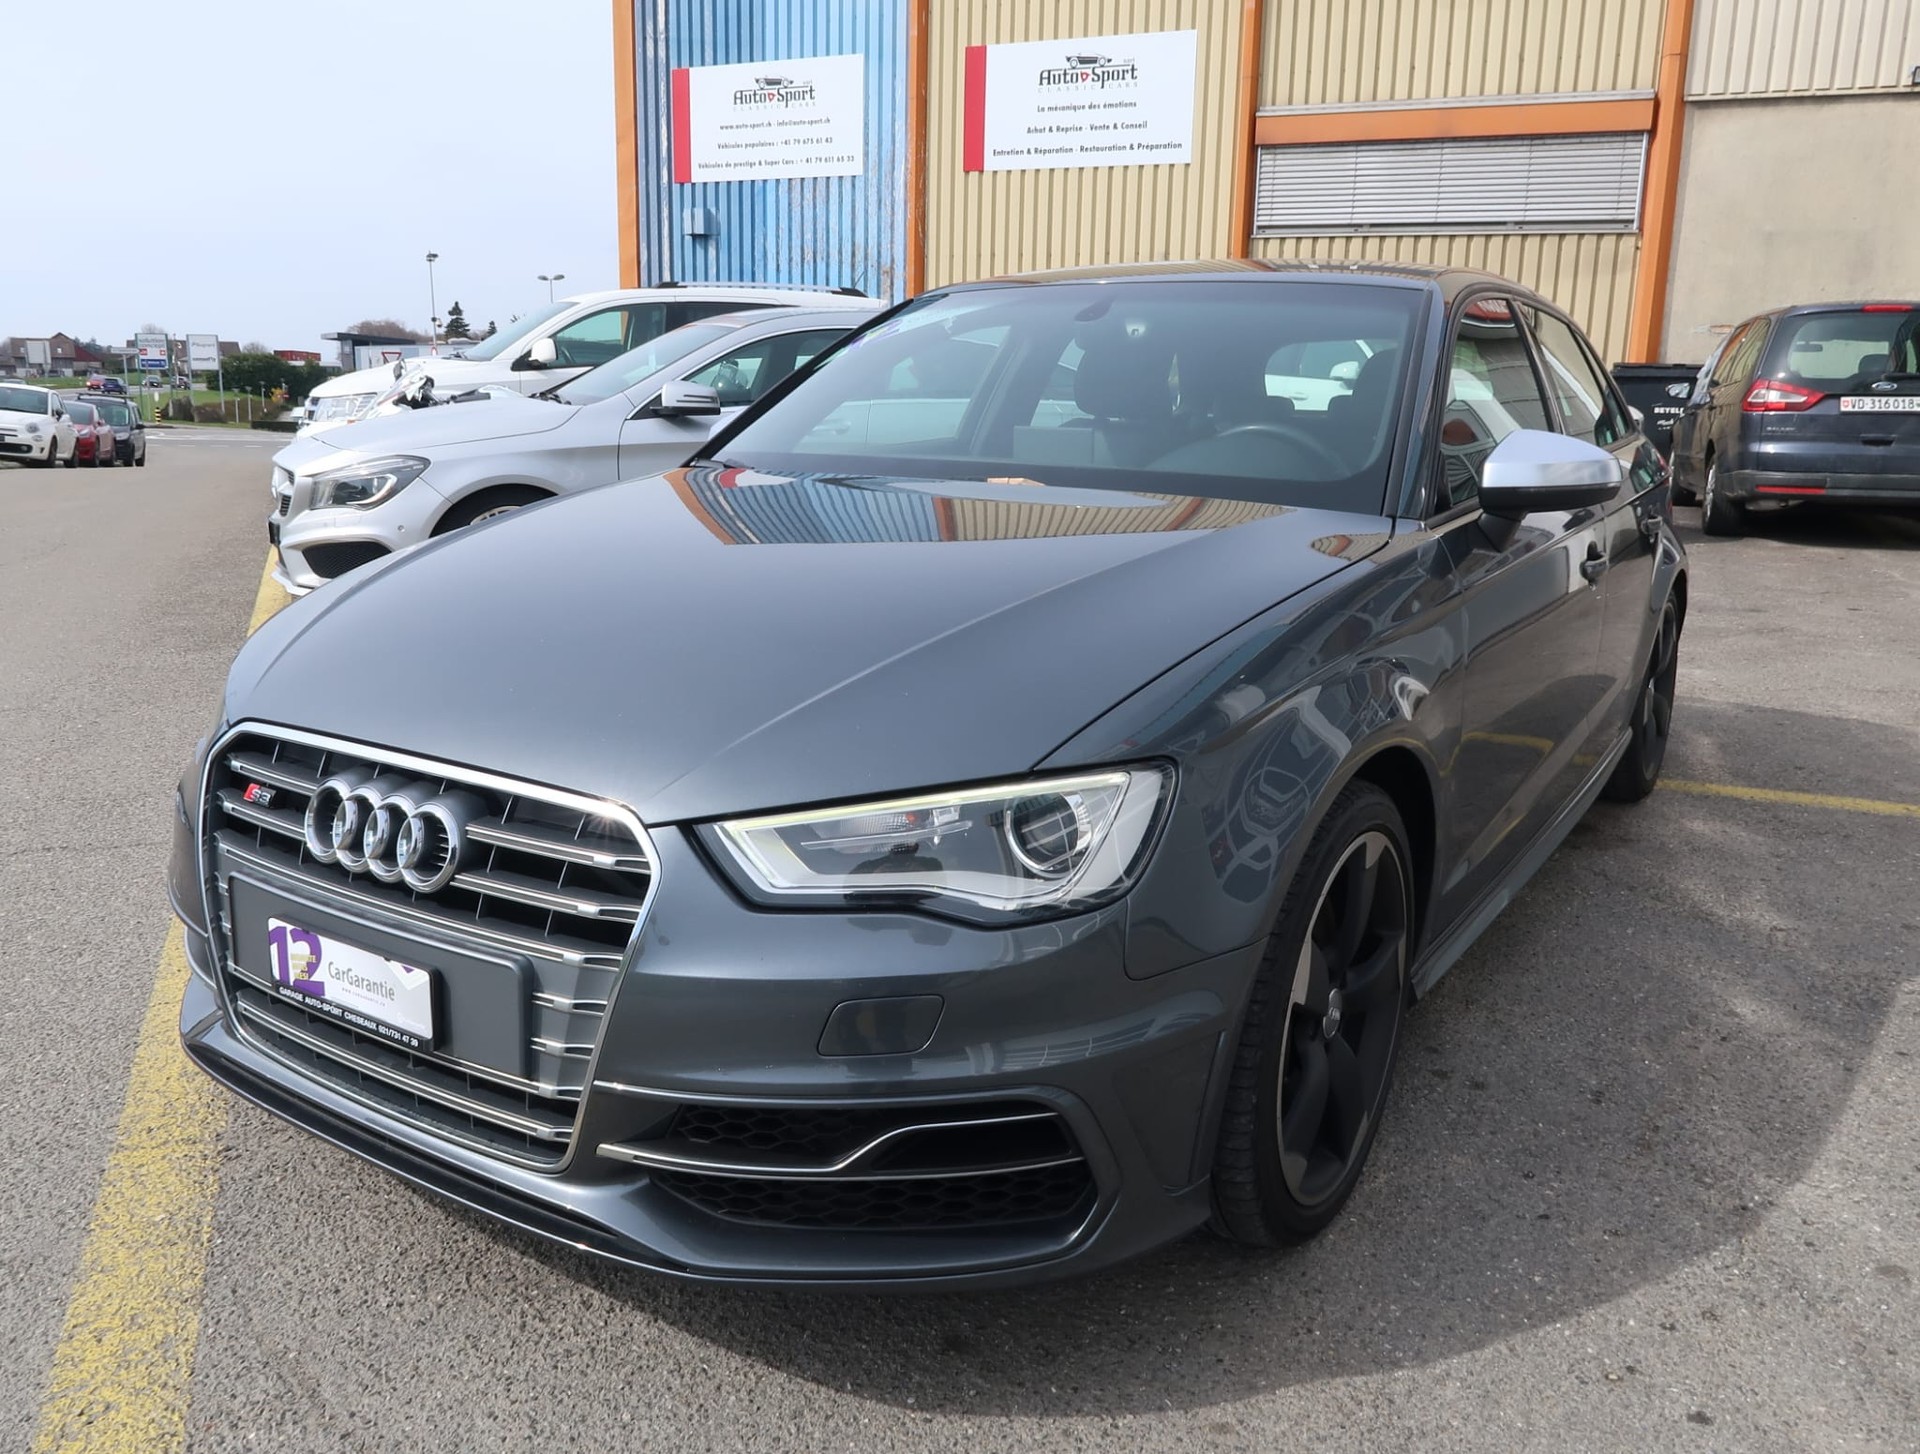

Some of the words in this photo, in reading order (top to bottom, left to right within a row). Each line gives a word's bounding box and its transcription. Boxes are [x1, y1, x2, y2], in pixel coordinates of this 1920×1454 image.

[1038, 68, 1079, 86] Auto
[1091, 64, 1138, 89] Sport
[733, 89, 767, 105] Auto
[777, 85, 816, 108] Sport
[1038, 85, 1096, 93] CLASSIC
[1037, 105, 1045, 113] La
[1047, 103, 1086, 112] mécanique
[1088, 101, 1100, 110] des
[1103, 100, 1137, 109] émotions
[1026, 125, 1046, 134] Achat
[1048, 125, 1053, 133] &
[1056, 124, 1083, 134] Reprise
[1089, 123, 1110, 131] Vente
[1113, 122, 1118, 130] &
[1121, 120, 1148, 130] Conseil
[745, 140, 775, 149] populaires
[992, 147, 1025, 157] Entretien
[1026, 147, 1032, 155] &
[1034, 146, 1074, 156] Réparation
[1079, 143, 1127, 153] Restauration
[1129, 143, 1135, 151] &
[1137, 141, 1183, 152] Préparation
[733, 160, 756, 169] prestige
[269, 925, 326, 997] 12
[327, 961, 396, 1002] CarGarantie
[279, 986, 304, 1002] GARAGE
[304, 996, 343, 1017] AUTO-SPORT
[344, 1011, 378, 1031] CHESEAUX
